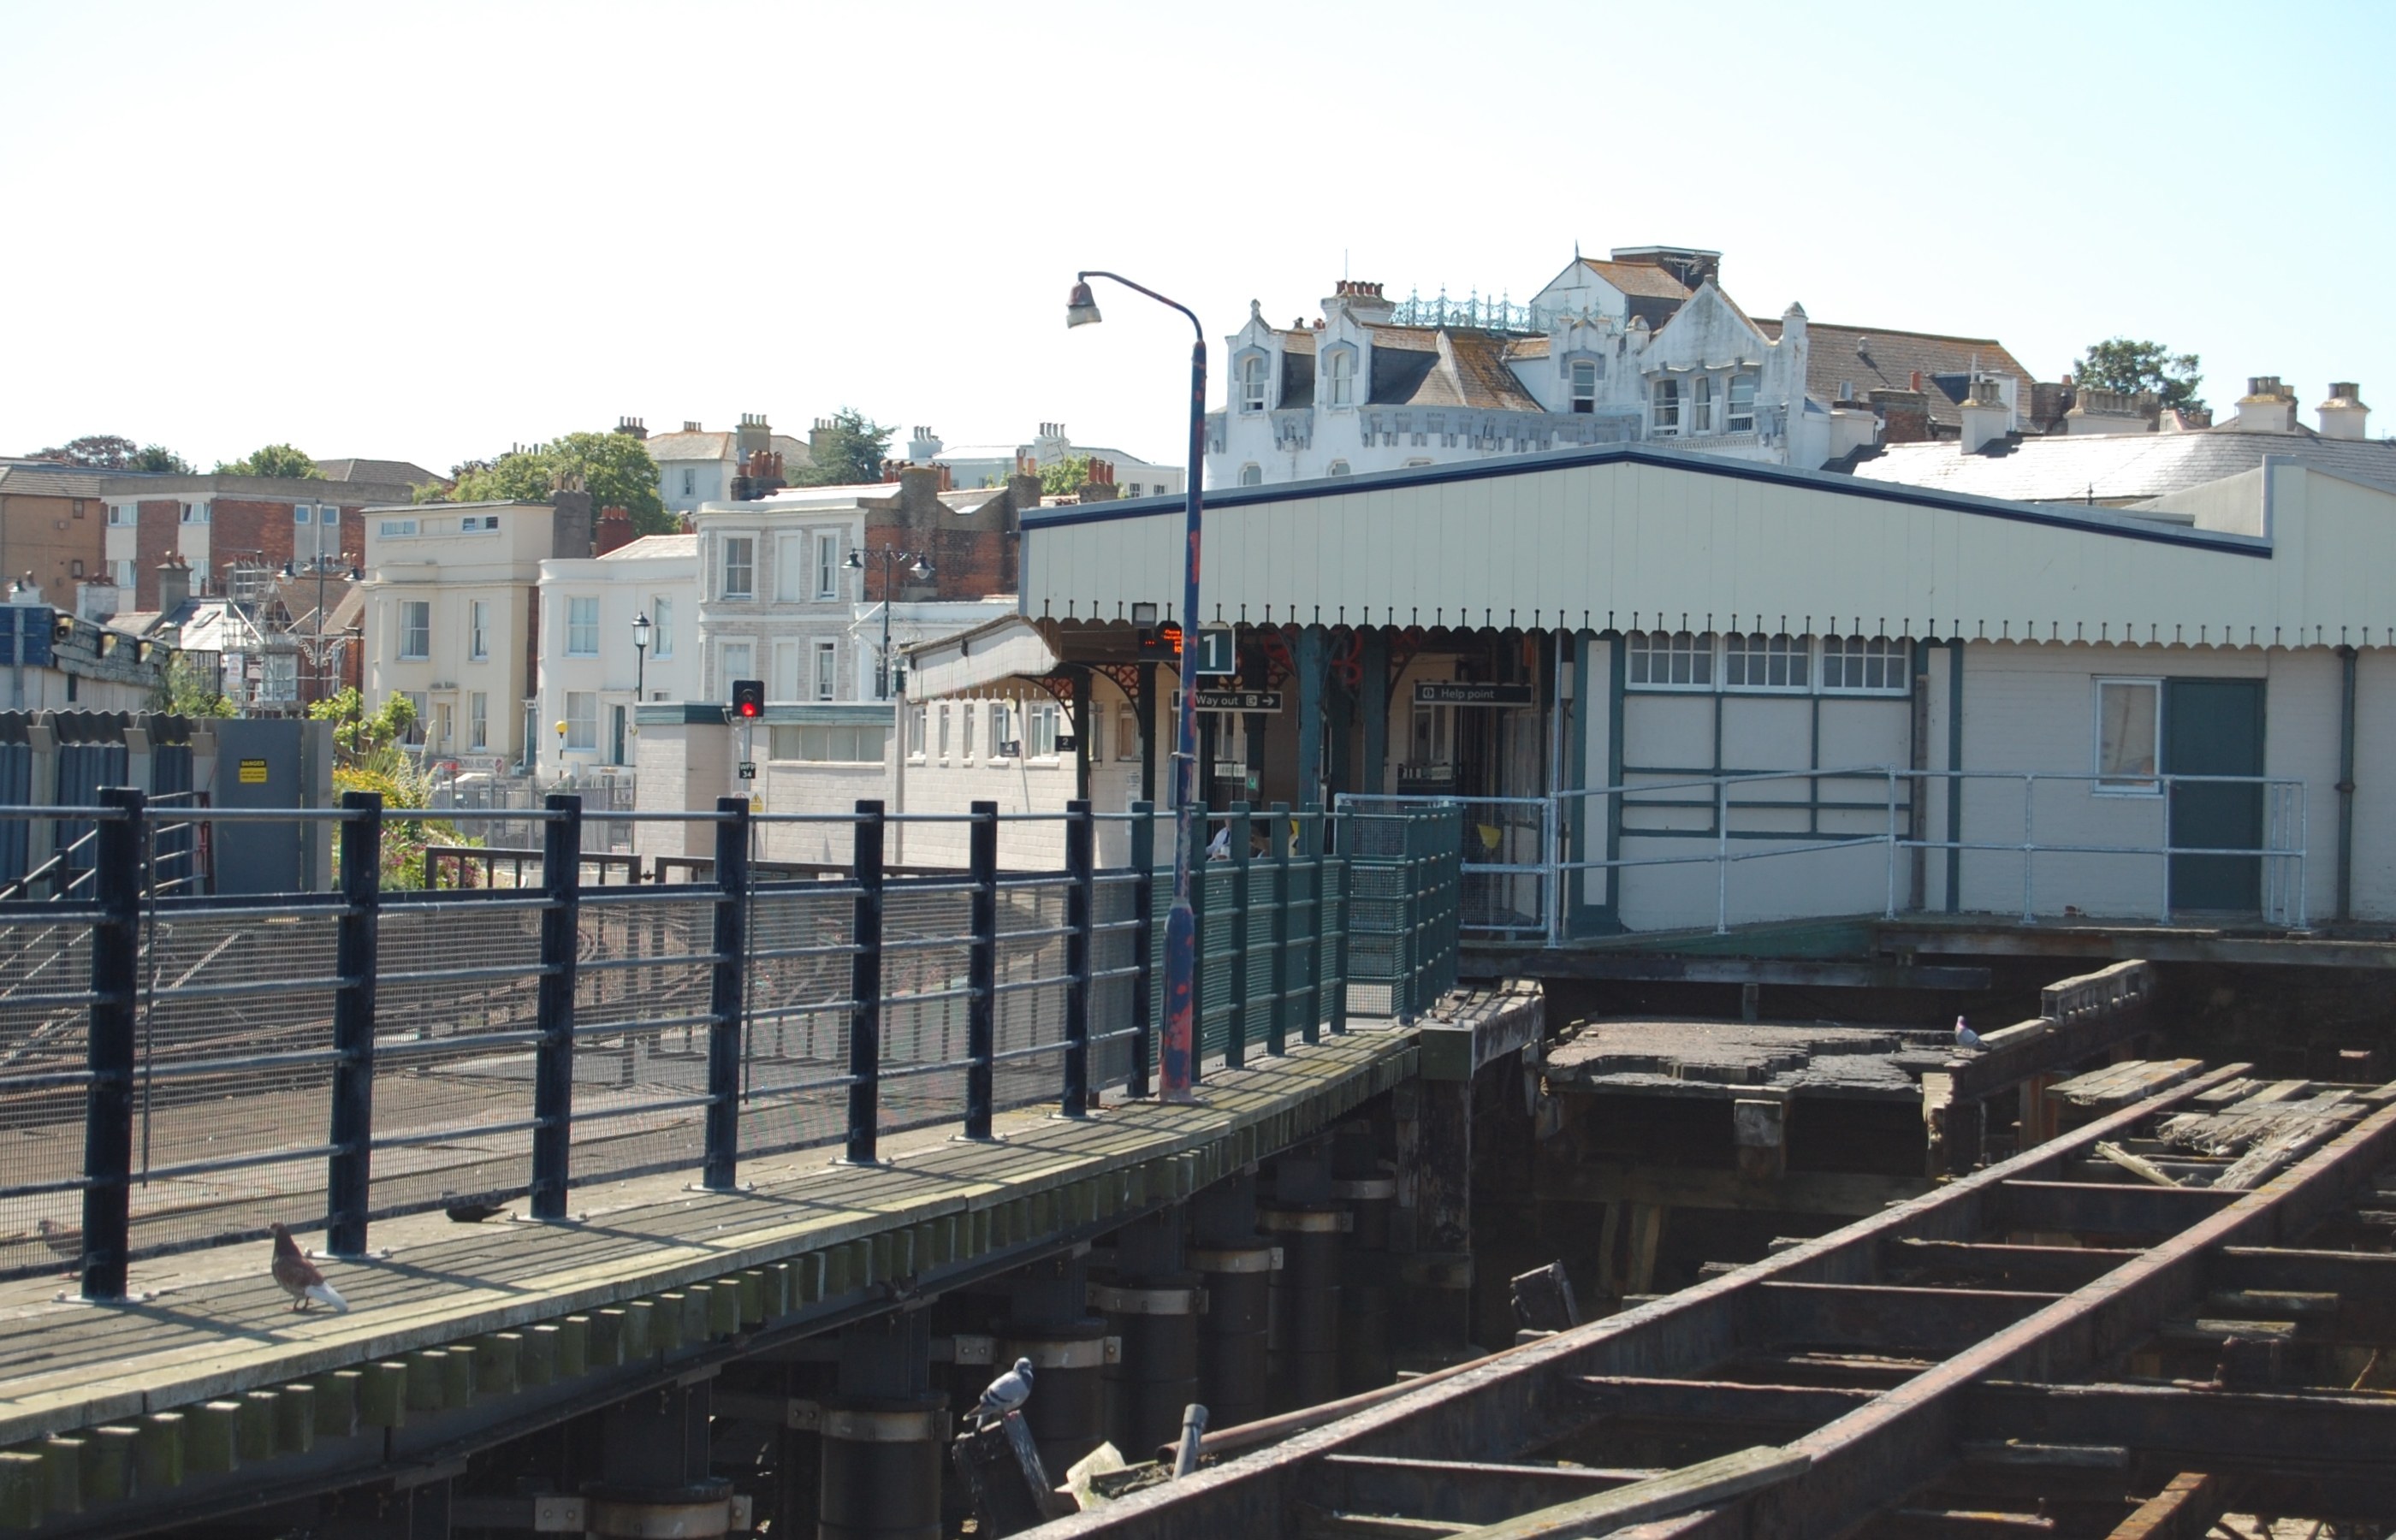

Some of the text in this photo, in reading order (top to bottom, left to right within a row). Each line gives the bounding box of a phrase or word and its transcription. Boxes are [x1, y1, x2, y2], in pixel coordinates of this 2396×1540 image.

[1203, 633, 1216, 667] 1
[1441, 688, 1494, 700] Help point
[1195, 694, 1239, 707] Way out
[1062, 737, 1069, 746] 2
